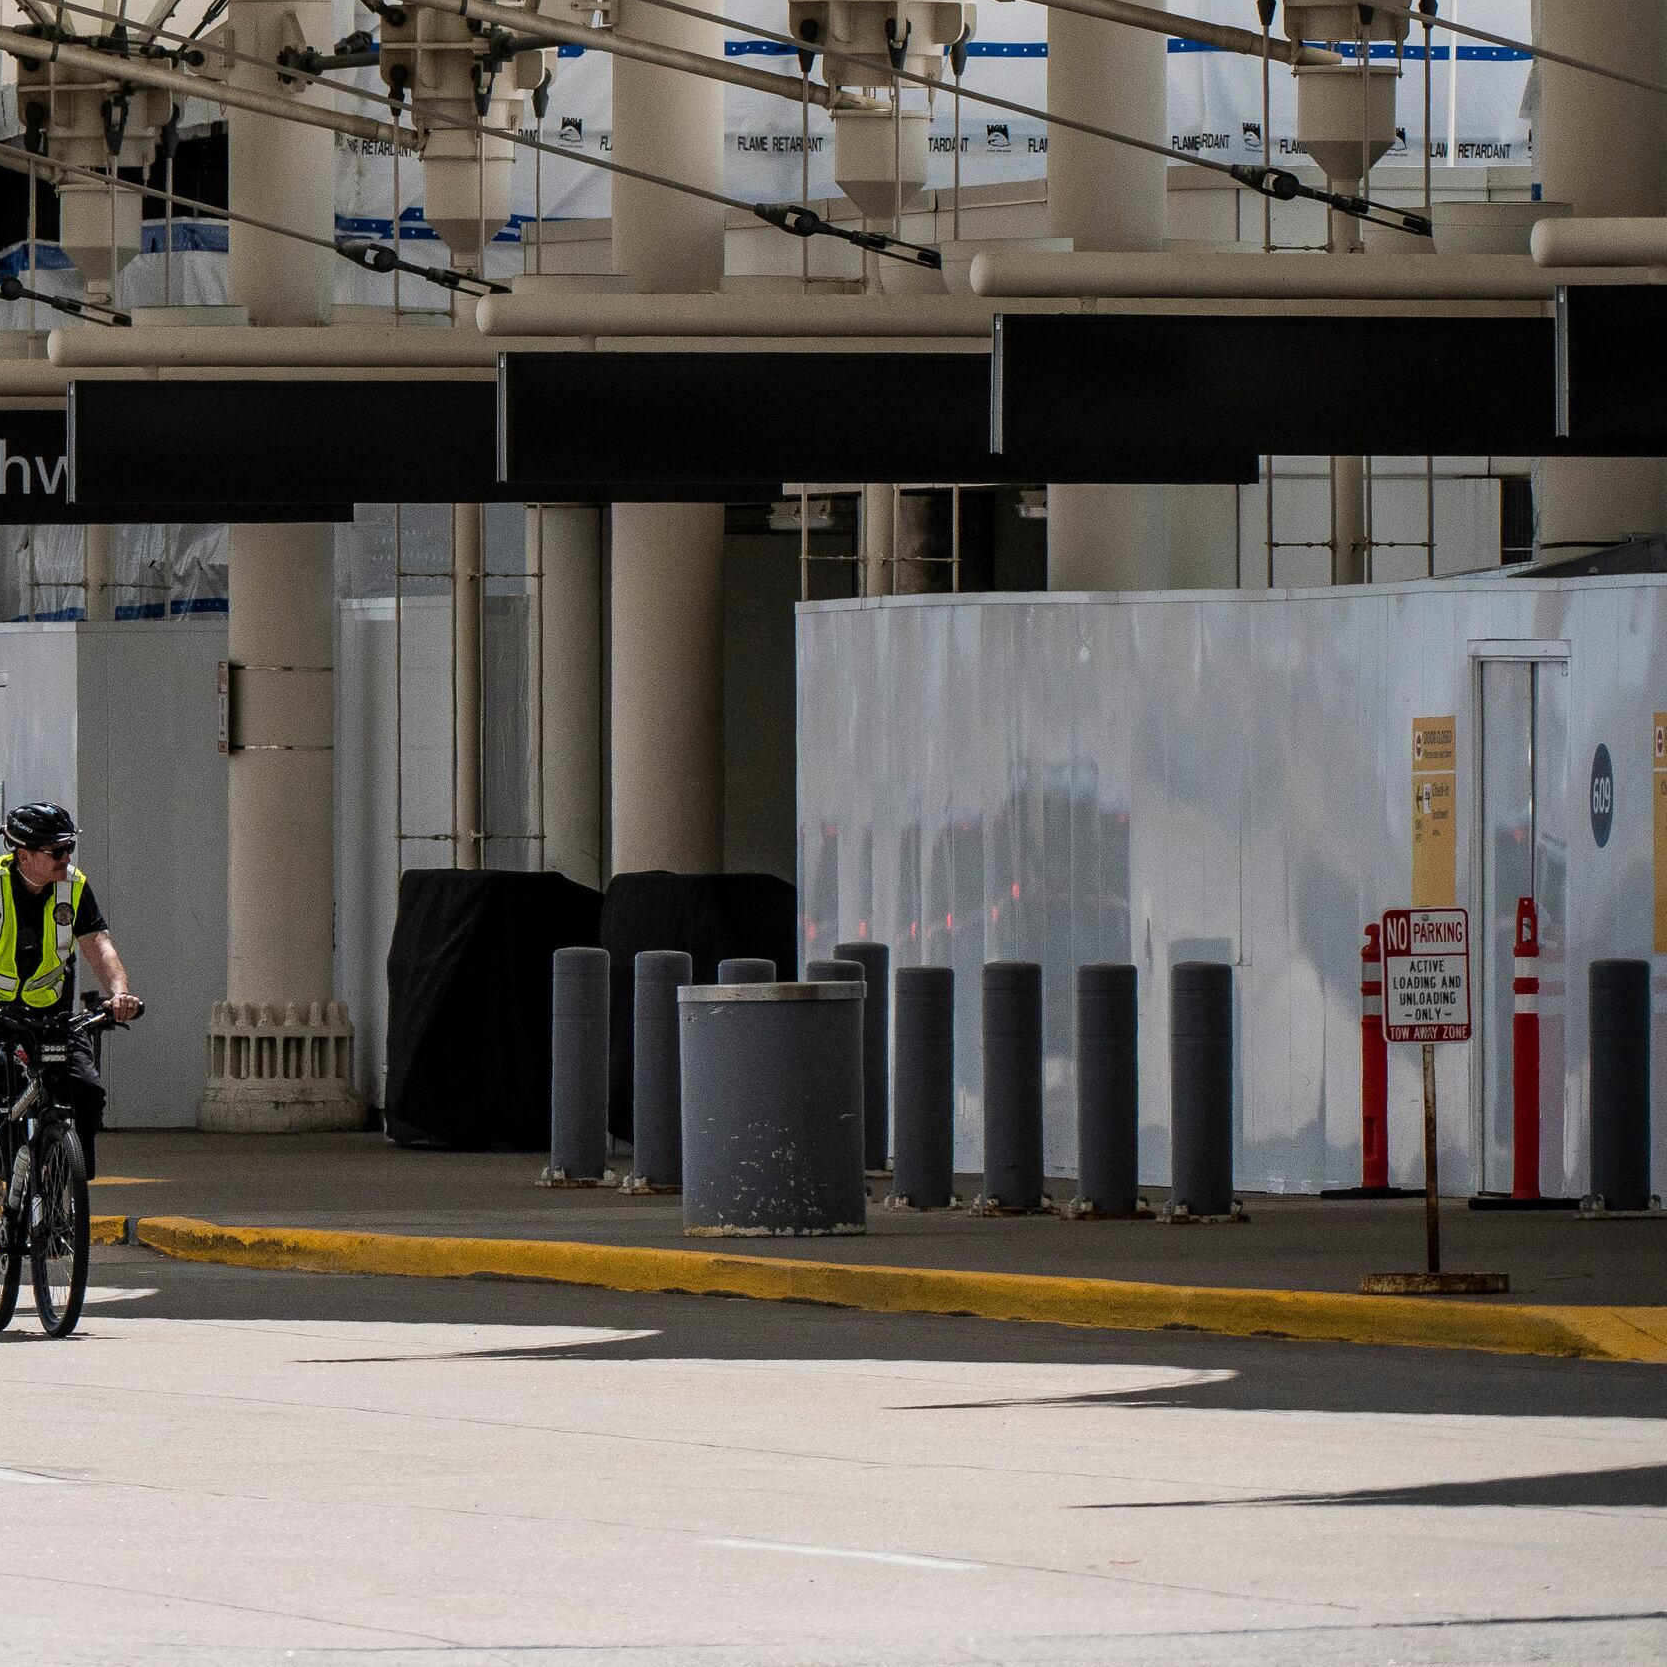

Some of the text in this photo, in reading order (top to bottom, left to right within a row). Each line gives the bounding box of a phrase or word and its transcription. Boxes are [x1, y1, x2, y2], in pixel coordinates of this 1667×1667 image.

[737, 136, 823, 152] FLAME RETARANT
[1457, 143, 1512, 160] RETARDANT
[1593, 776, 1611, 814] 609
[1387, 917, 1463, 951] NO PARKING
[1409, 960, 1445, 973] ACTIVE
[1393, 975, 1462, 990] LOADING AND
[1399, 992, 1456, 1006] UNLOADING
[1389, 1026, 1410, 1040] TOW
[1443, 1025, 1468, 1040] ZONE
